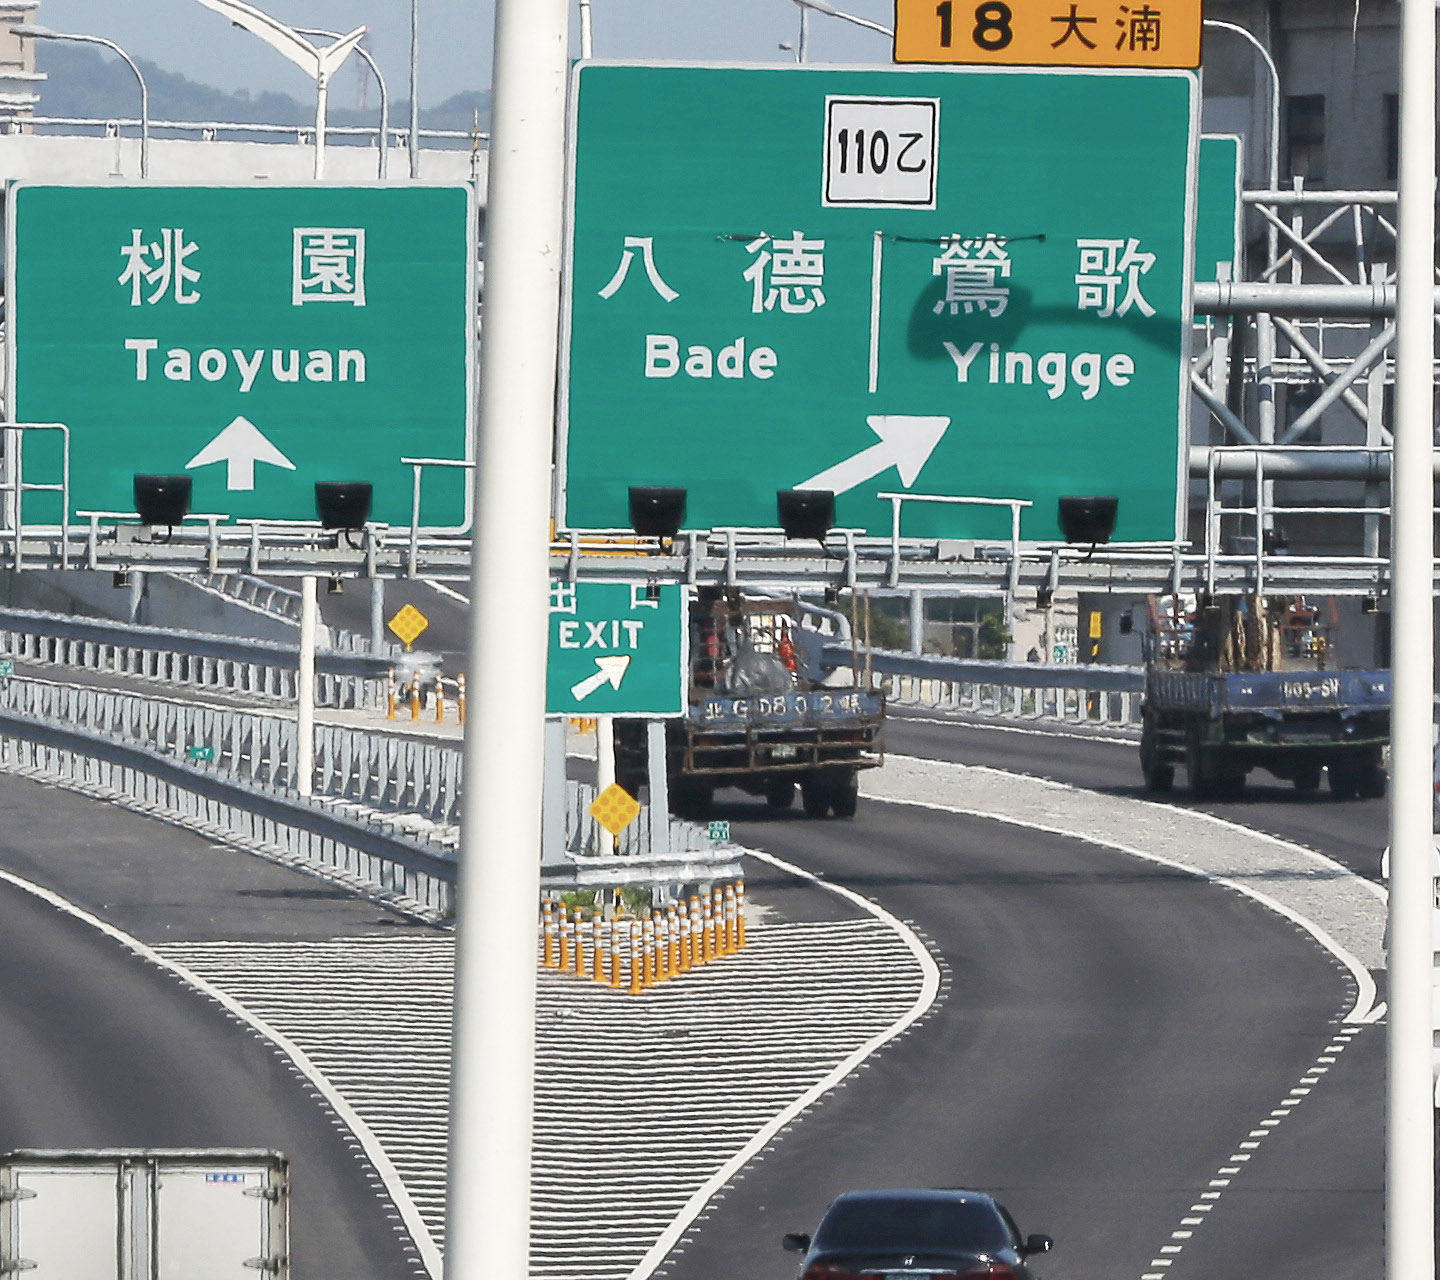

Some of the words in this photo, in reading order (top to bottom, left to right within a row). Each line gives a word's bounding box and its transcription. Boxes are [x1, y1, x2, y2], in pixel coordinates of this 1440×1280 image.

[936, 0, 1013, 52] 18
[1050, 3, 1161, 52] 大湳
[117, 227, 367, 307] 桃園
[597, 231, 826, 314] 八德
[931, 233, 1157, 319] 鶯歌
[124, 338, 367, 393] Taoyuan
[644, 334, 779, 380] Bade
[943, 341, 1136, 401] Yingge
[559, 619, 644, 650] EXIT
